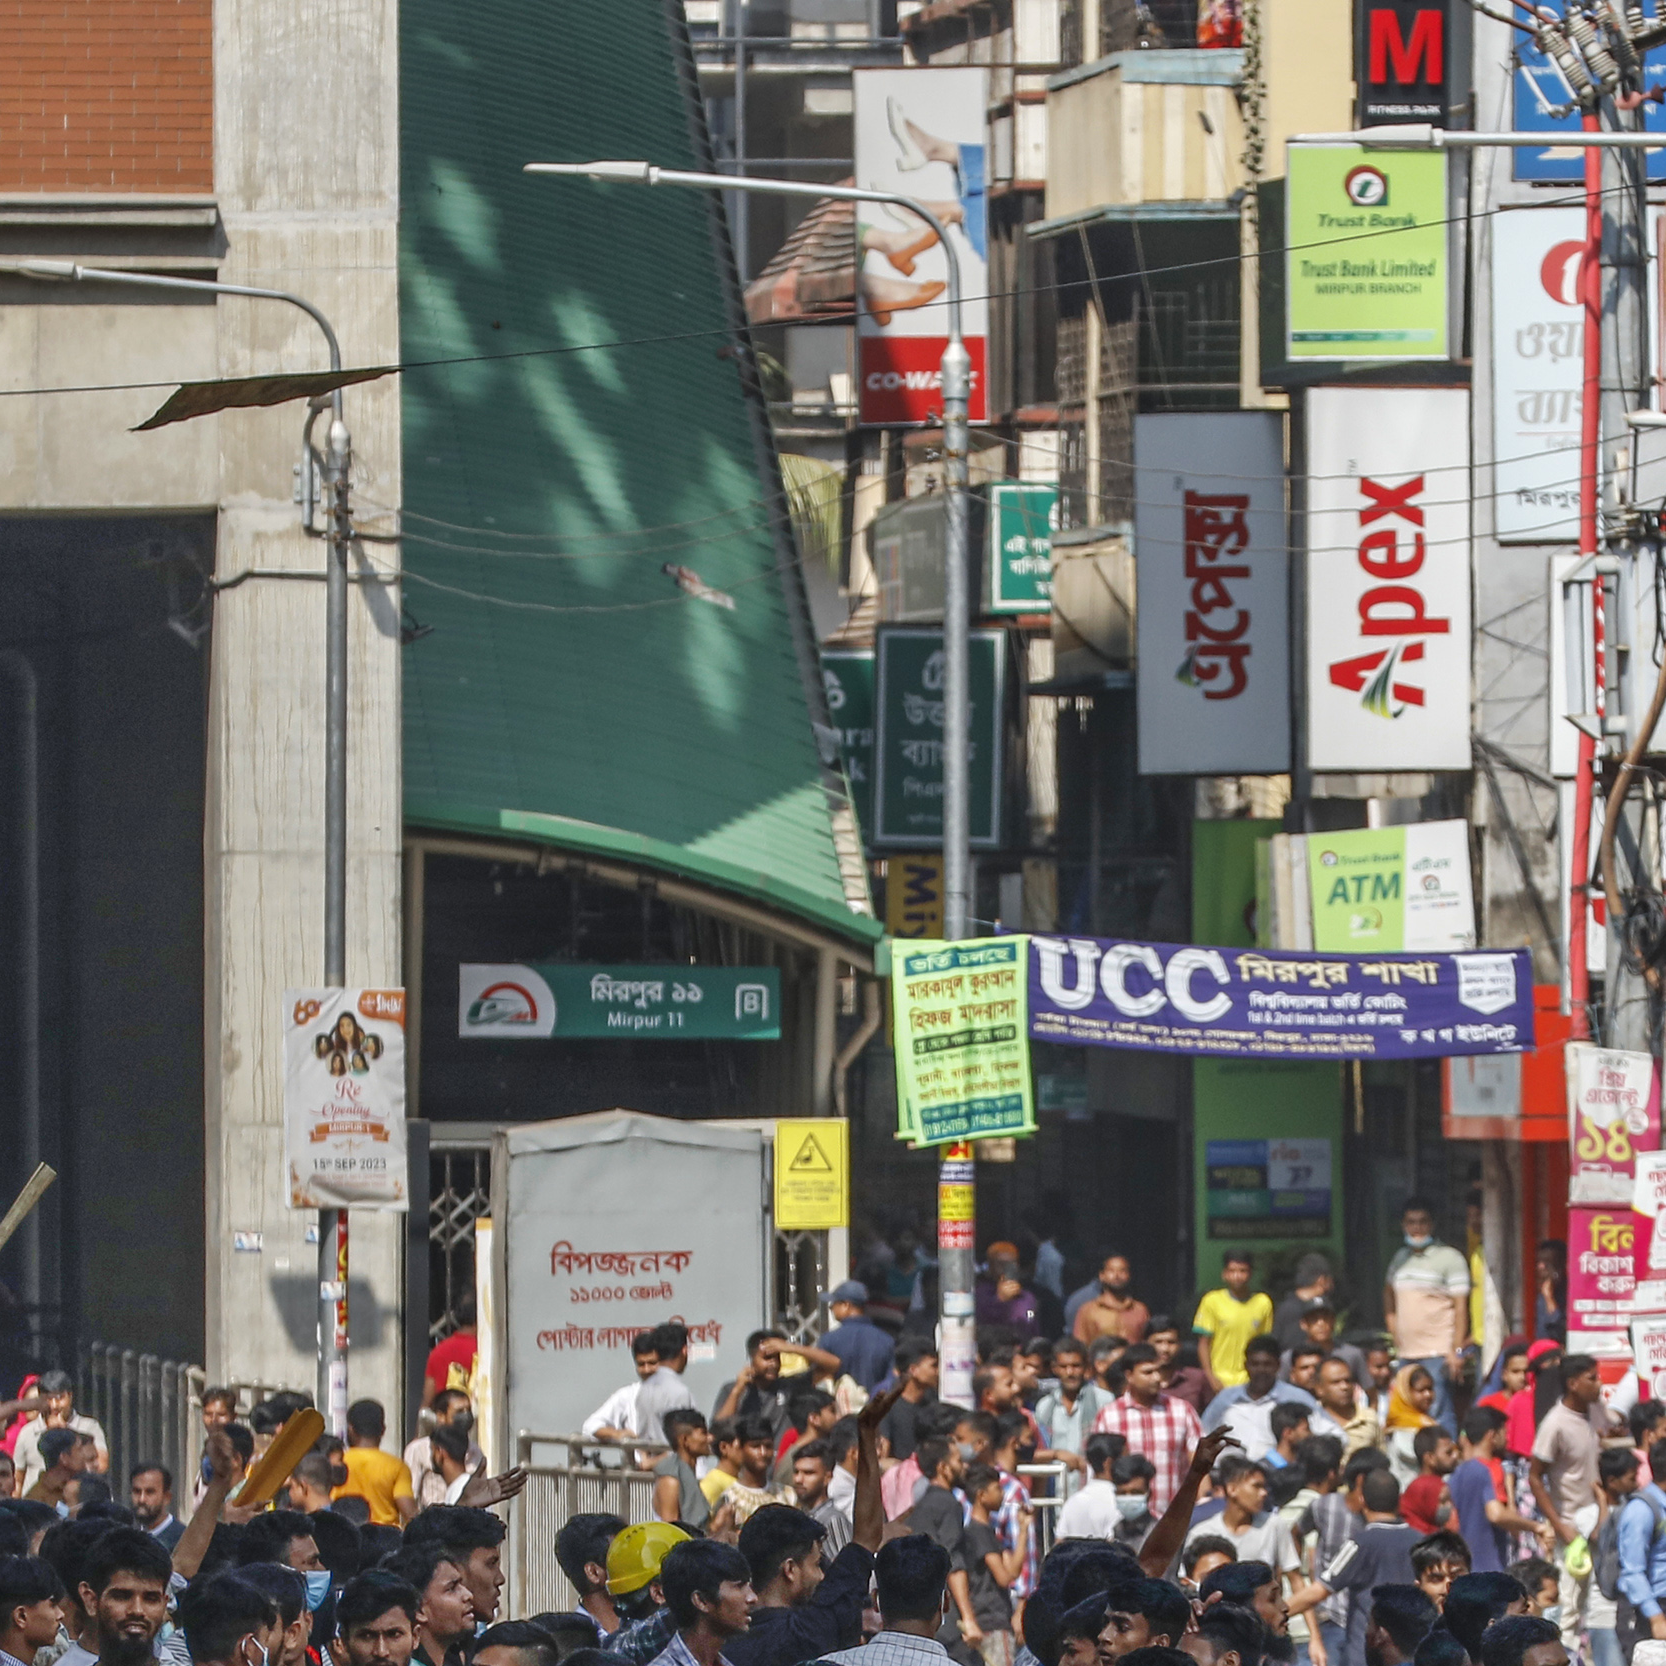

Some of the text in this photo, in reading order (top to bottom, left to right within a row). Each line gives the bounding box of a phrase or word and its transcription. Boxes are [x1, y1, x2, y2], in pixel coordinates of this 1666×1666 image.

[1369, 9, 1443, 84] M
[1318, 213, 1364, 227] Trust
[1301, 258, 1436, 278] Trust Bank Limited
[1315, 282, 1366, 294] MIRPUR
[1328, 475, 1450, 707] Apex
[1327, 872, 1401, 905] ATM
[1033, 936, 1233, 1023] UCC
[1236, 953, 1350, 989] মিরপুর
[1358, 960, 1439, 985] শাখা
[590, 974, 704, 1010] মিরপুর ১১
[607, 1011, 686, 1031] Mirpur 11
[334, 1158, 357, 1170] SEP
[359, 1158, 387, 1170] 2023
[550, 1240, 693, 1277] বিপজ্জনক
[569, 1286, 625, 1304] ১১০০০
